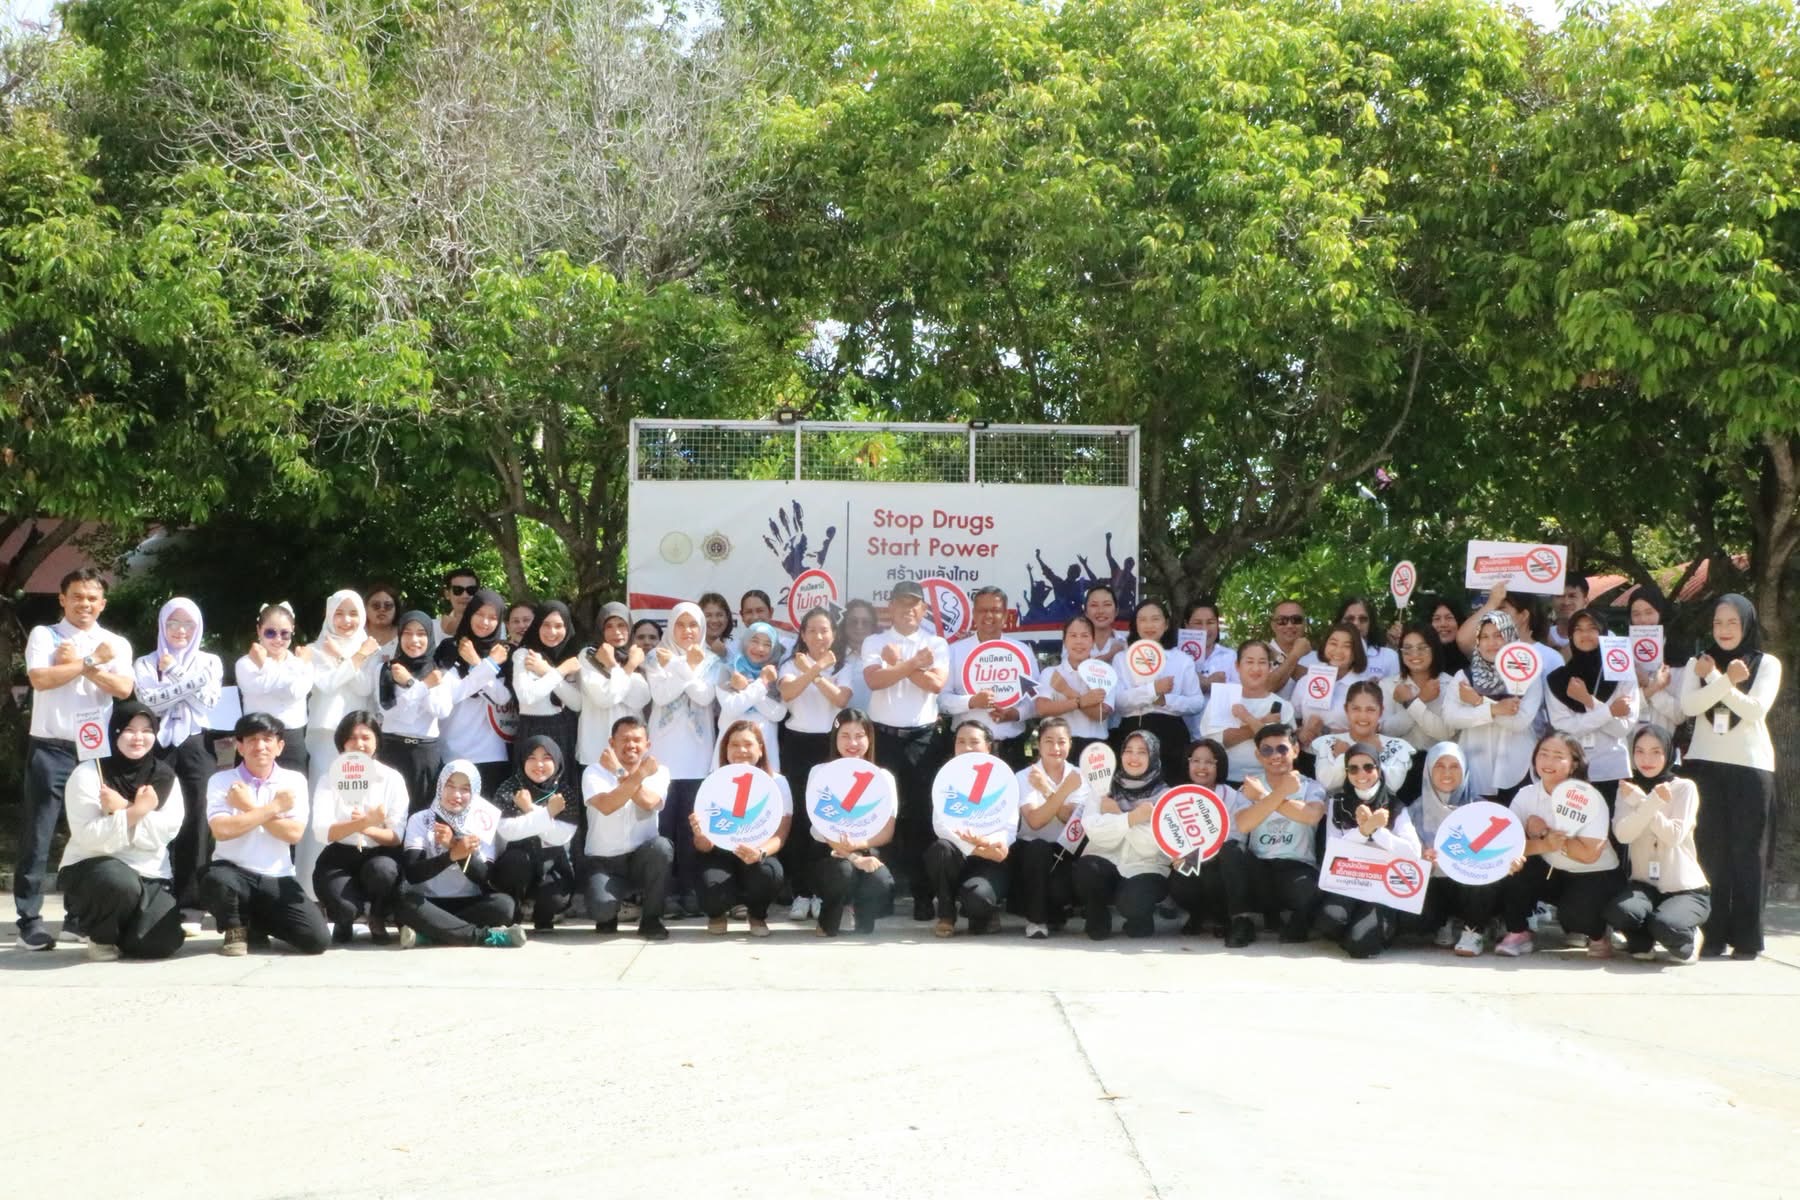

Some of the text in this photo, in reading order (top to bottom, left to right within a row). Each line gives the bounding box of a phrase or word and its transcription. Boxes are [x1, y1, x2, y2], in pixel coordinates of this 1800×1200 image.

[873, 508, 995, 536] Stop Drugs
[867, 537, 999, 558] Start Power
[886, 564, 979, 581] สร้างพลังไทย
[796, 593, 828, 610] ไม่เอา
[974, 663, 1018, 682] ไม่เอา
[840, 770, 875, 813] 1
[968, 762, 994, 805] 1
[731, 772, 753, 819] 1
[821, 804, 840, 818] BE
[949, 802, 968, 814] BE
[715, 818, 734, 831] BE
[1175, 796, 1206, 847] ไม่เอา
[1469, 815, 1512, 853] 1
[1448, 843, 1465, 857] BE
